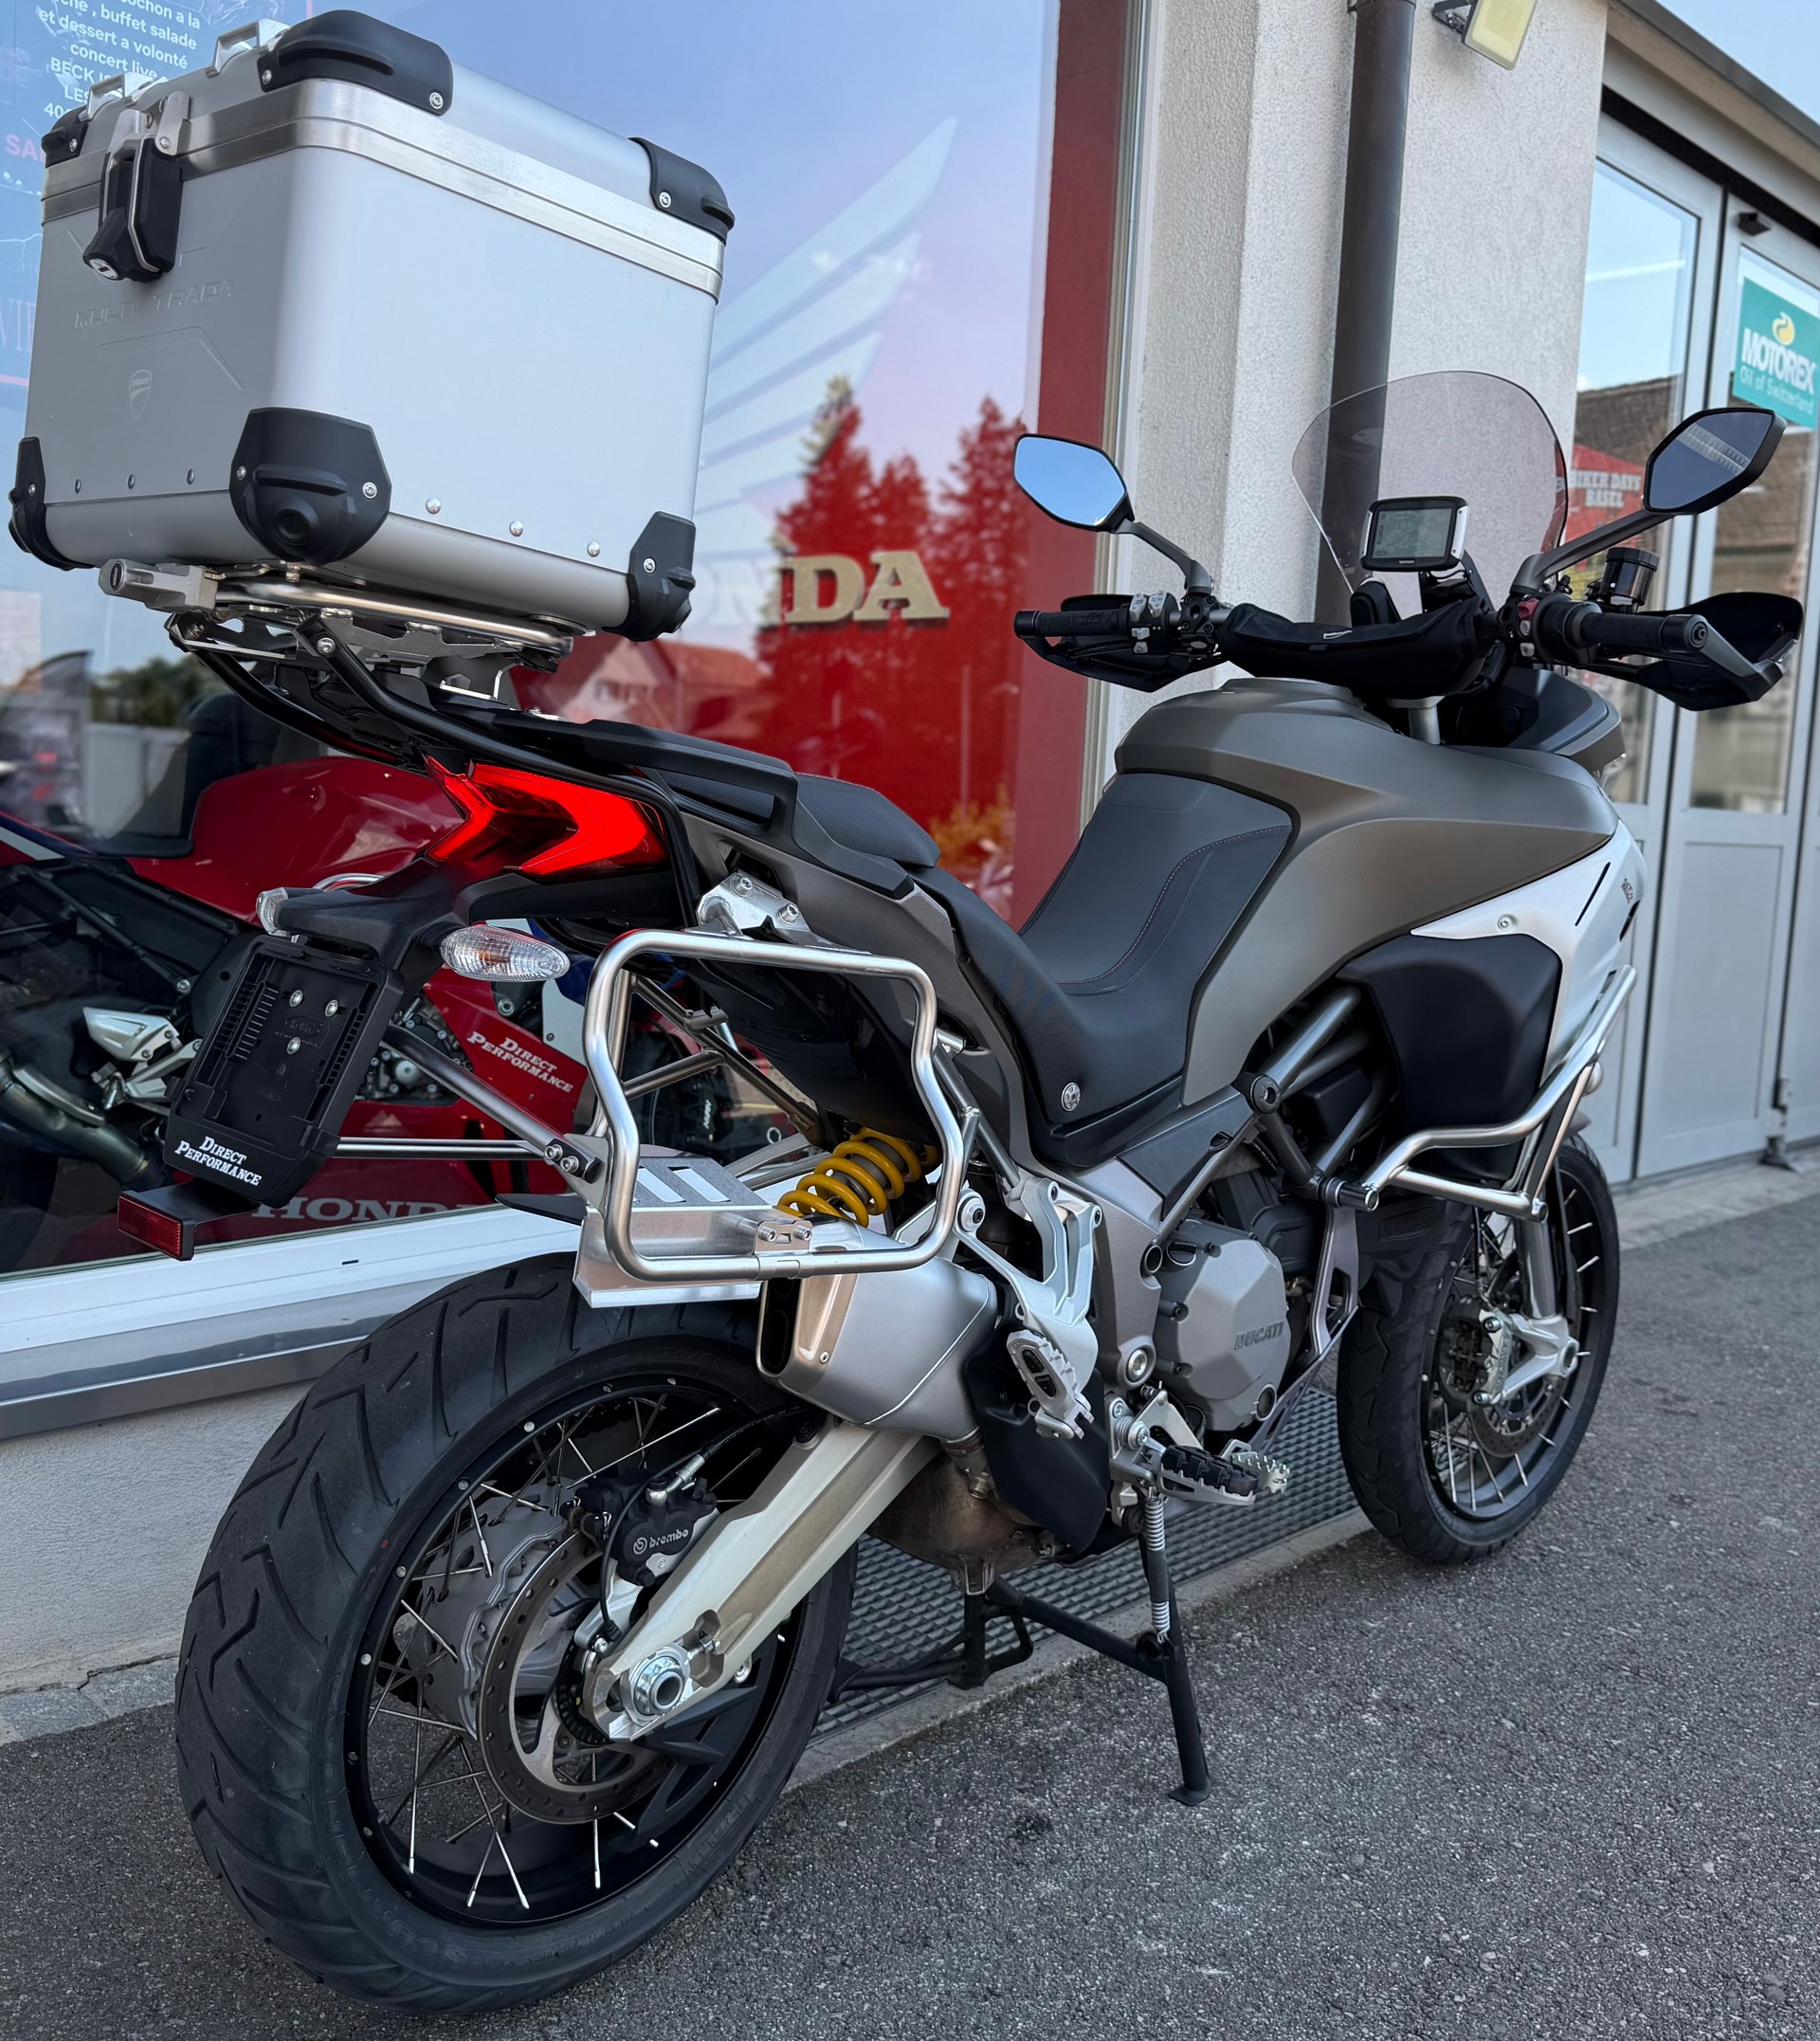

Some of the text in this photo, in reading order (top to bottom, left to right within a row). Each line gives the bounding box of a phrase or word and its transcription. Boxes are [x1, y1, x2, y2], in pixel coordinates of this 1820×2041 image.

[101, 4, 147, 33] buffet
[150, 24, 197, 50] salade
[120, 0, 200, 29] ochon a la
[39, 9, 189, 69] et dessert a volonté
[50, 57, 95, 83] BECK
[70, 44, 128, 72] concert
[1741, 326, 1817, 395] MOTOREX
[1740, 365, 1814, 415] Oil of Switzerland
[1570, 469, 1642, 493] BIKER DAYS
[1585, 489, 1625, 508] BASEL
[466, 1031, 573, 1093] PERFORMANCE
[500, 1037, 557, 1072] DIRECT
[174, 1139, 263, 1186] PERFORMANCE
[199, 1136, 246, 1165] DIRECT
[1234, 1321, 1284, 1351] DUCATI
[649, 1529, 689, 1548] brembo
